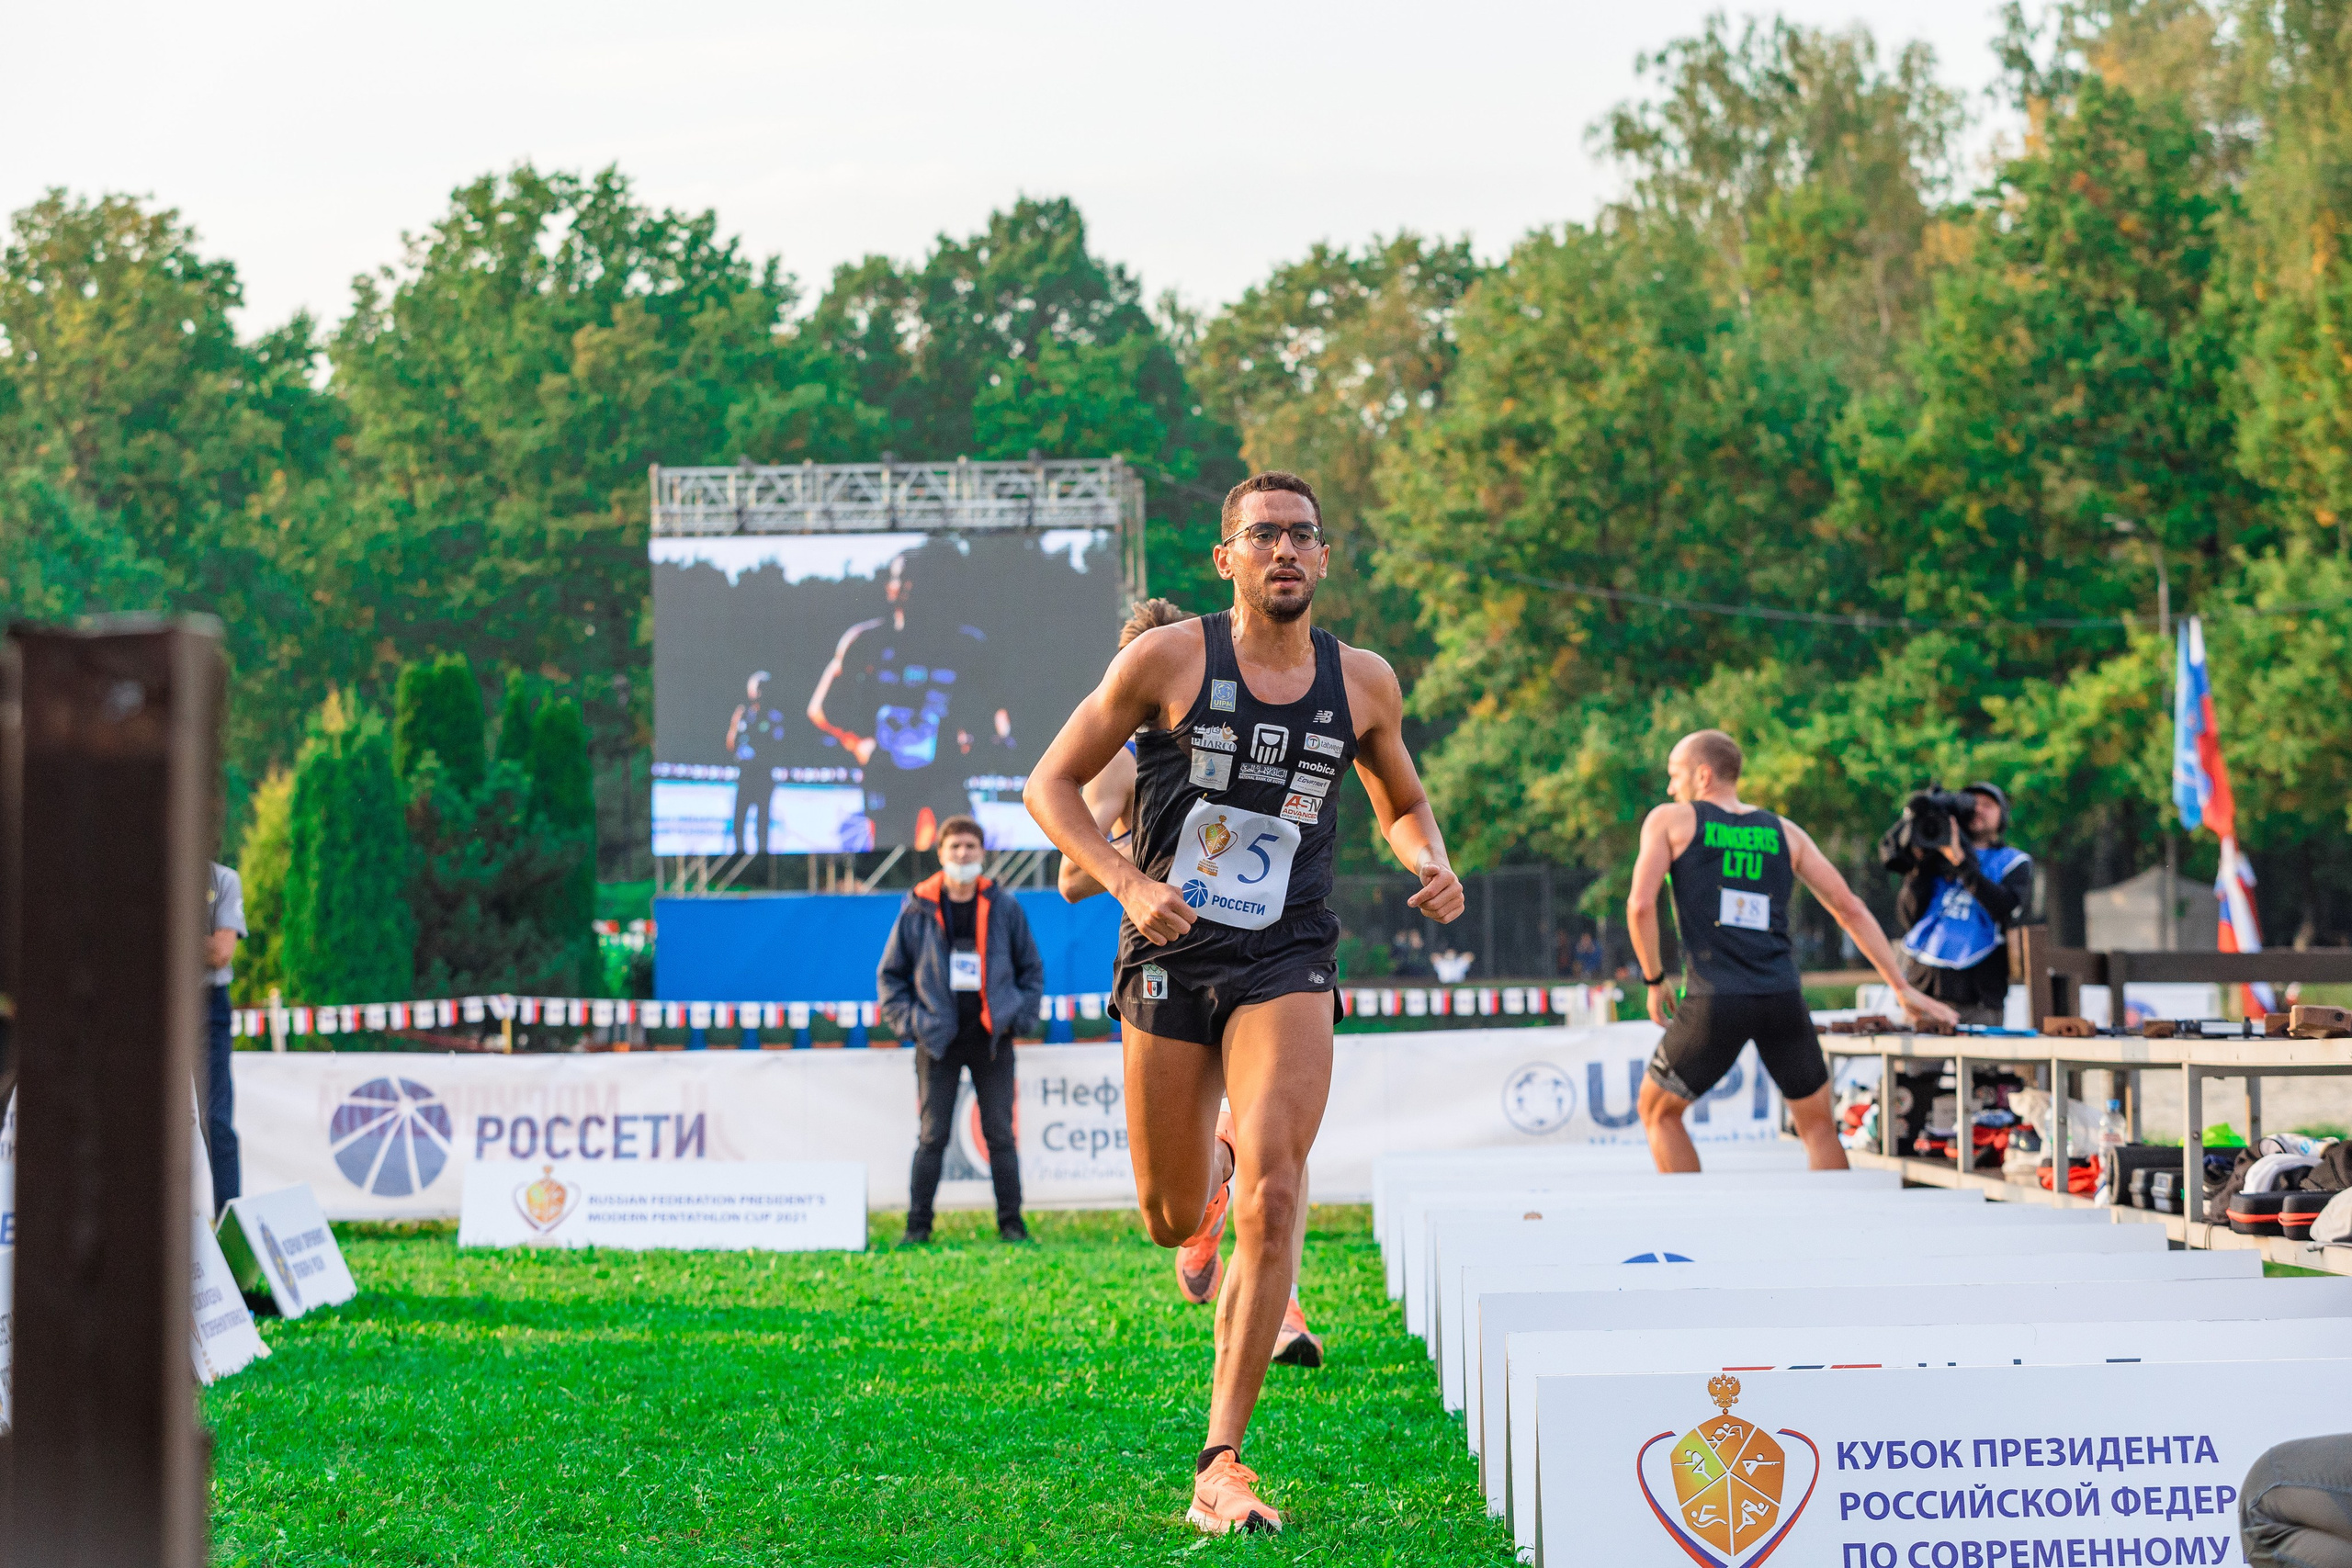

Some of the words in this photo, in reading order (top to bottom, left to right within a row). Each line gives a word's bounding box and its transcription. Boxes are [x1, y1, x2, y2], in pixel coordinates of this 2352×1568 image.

[1214, 699, 1233, 707] UIPM
[1193, 738, 1237, 751] PHARCO
[1298, 760, 1335, 775] mobica.
[1296, 775, 1324, 787] EGYPTAIR
[1283, 808, 1317, 819] ADVANCED
[1284, 795, 1322, 813] ASN
[1704, 820, 1780, 855] KINDERIS
[1237, 832, 1280, 885] 5
[1723, 850, 1763, 880] LTU
[1211, 894, 1266, 916] РОССЕТИ
[1042, 1077, 1124, 1115] Неф
[476, 1111, 707, 1161] РОССЕТИ
[589, 1194, 648, 1205] RUSSIAN
[651, 1194, 736, 1205] FEDERATION
[740, 1193, 826, 1205] PRESIDENT'S
[588, 1212, 649, 1223] MODERN
[651, 1212, 741, 1223] PENTATHLON
[744, 1212, 772, 1223] CUP
[776, 1212, 808, 1223] 2021
[1837, 1438, 1962, 1470] КУБОК
[1973, 1435, 2220, 1472] ПРЕЗИДЕНТА
[1839, 1481, 2100, 1521] РОССИЙСКОЙ
[2111, 1484, 2237, 1521] ФЕДЕР
[1842, 1542, 1898, 1568] ПО
[1907, 1536, 2231, 1568] СОВРЕМЕННОМУ
